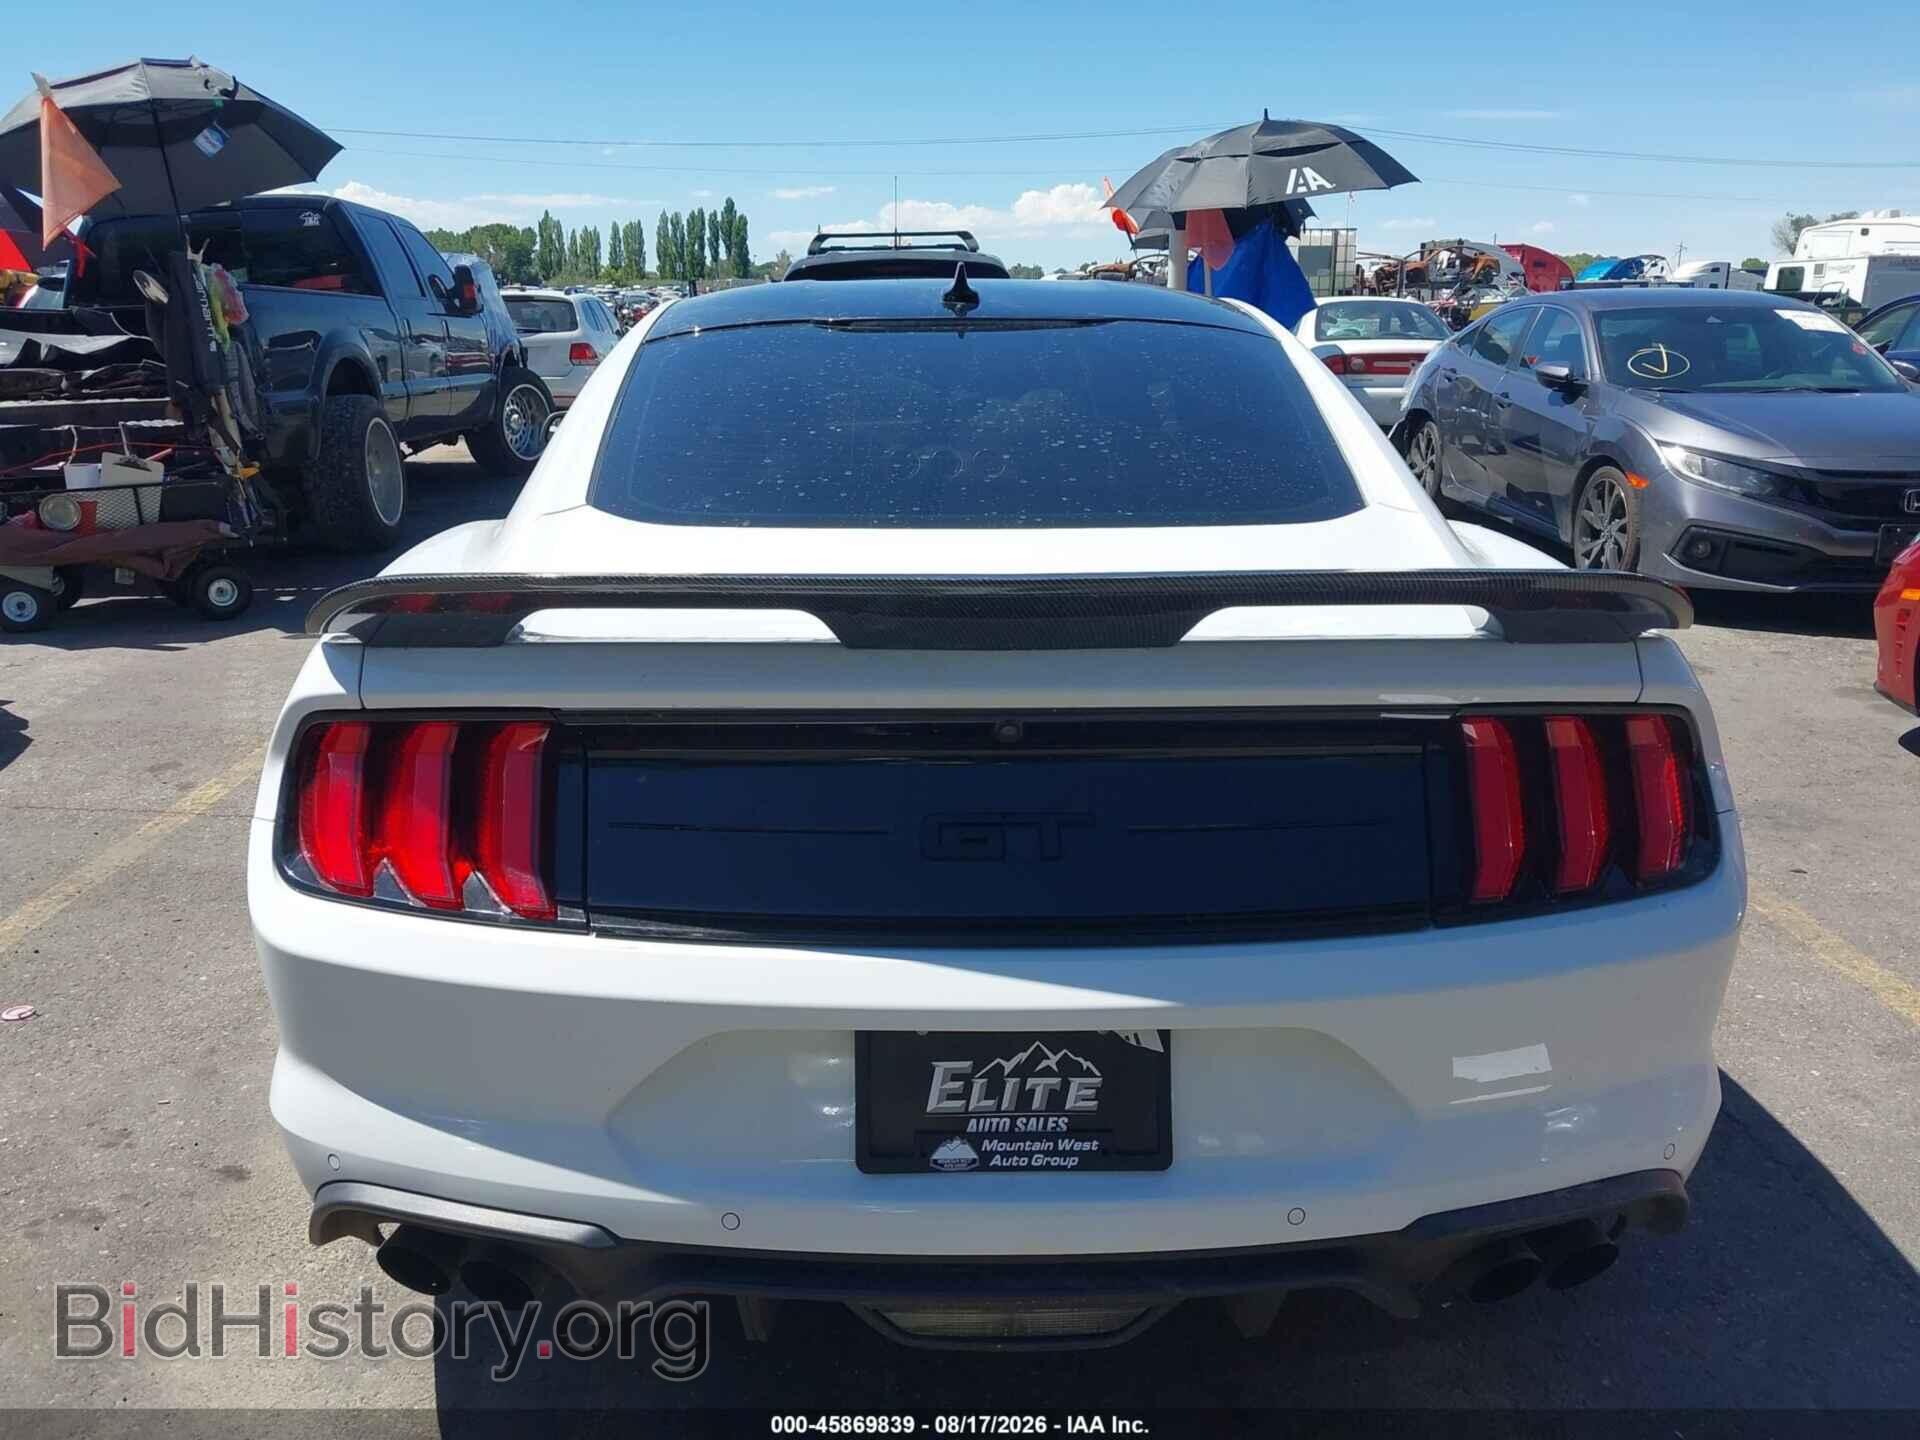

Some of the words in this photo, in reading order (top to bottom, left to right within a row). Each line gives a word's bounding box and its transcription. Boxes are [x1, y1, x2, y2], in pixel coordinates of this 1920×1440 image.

[919, 811, 1096, 862] GT
[966, 1117, 1011, 1133] AUTO
[1014, 1116, 1069, 1133] SALES
[981, 1138, 1054, 1152] Mountain
[1057, 1138, 1099, 1151] West
[989, 1154, 1028, 1167] Auto
[1031, 1154, 1079, 1168] Group
